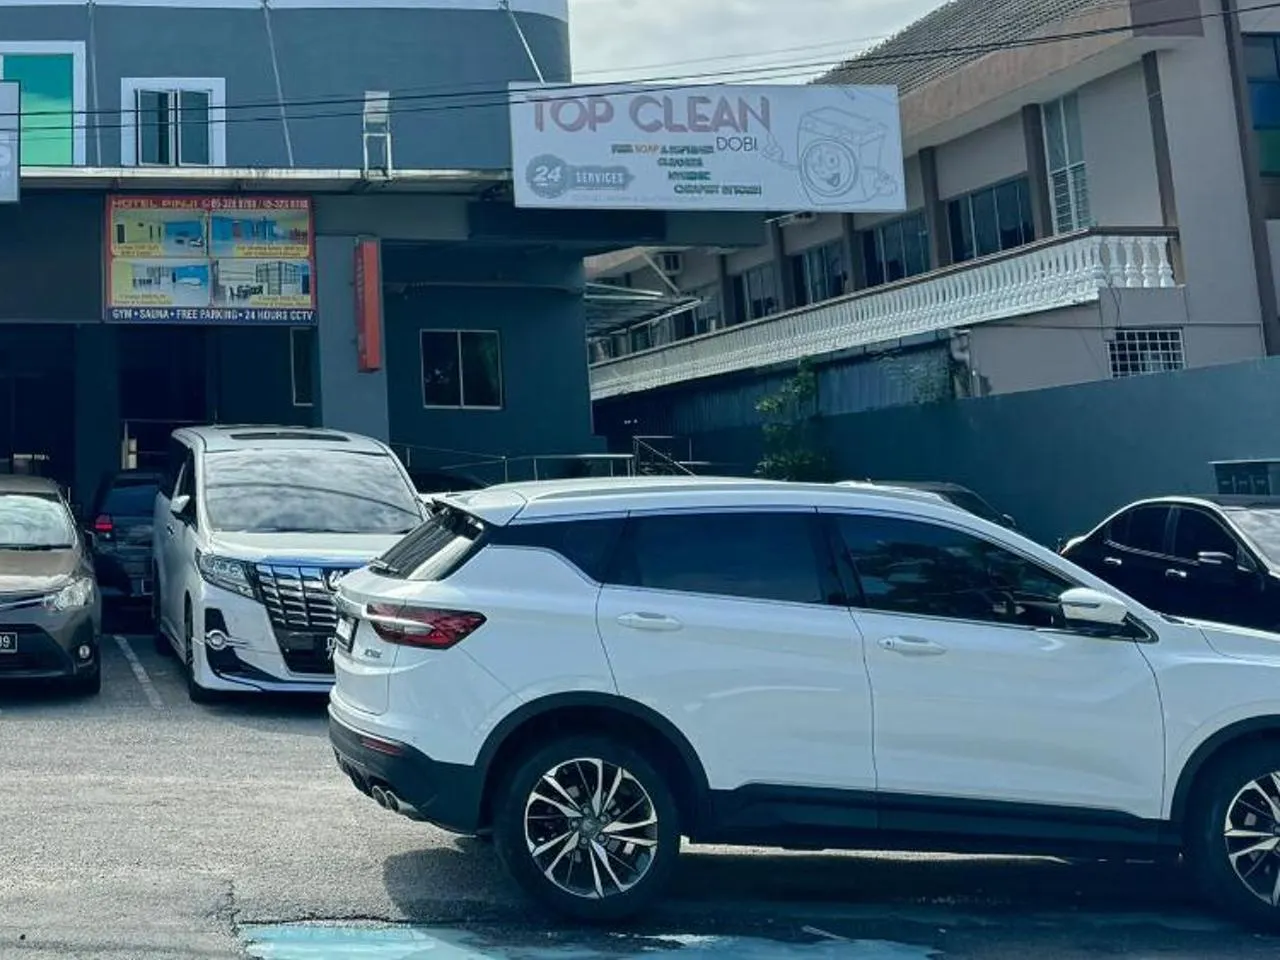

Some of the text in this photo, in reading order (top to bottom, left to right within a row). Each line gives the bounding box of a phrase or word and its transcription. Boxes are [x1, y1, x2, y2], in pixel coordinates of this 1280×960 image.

[526, 95, 770, 133] TOP CLEAN
[716, 136, 758, 152] DOBI
[533, 165, 562, 183] 24
[176, 309, 198, 319] FREE
